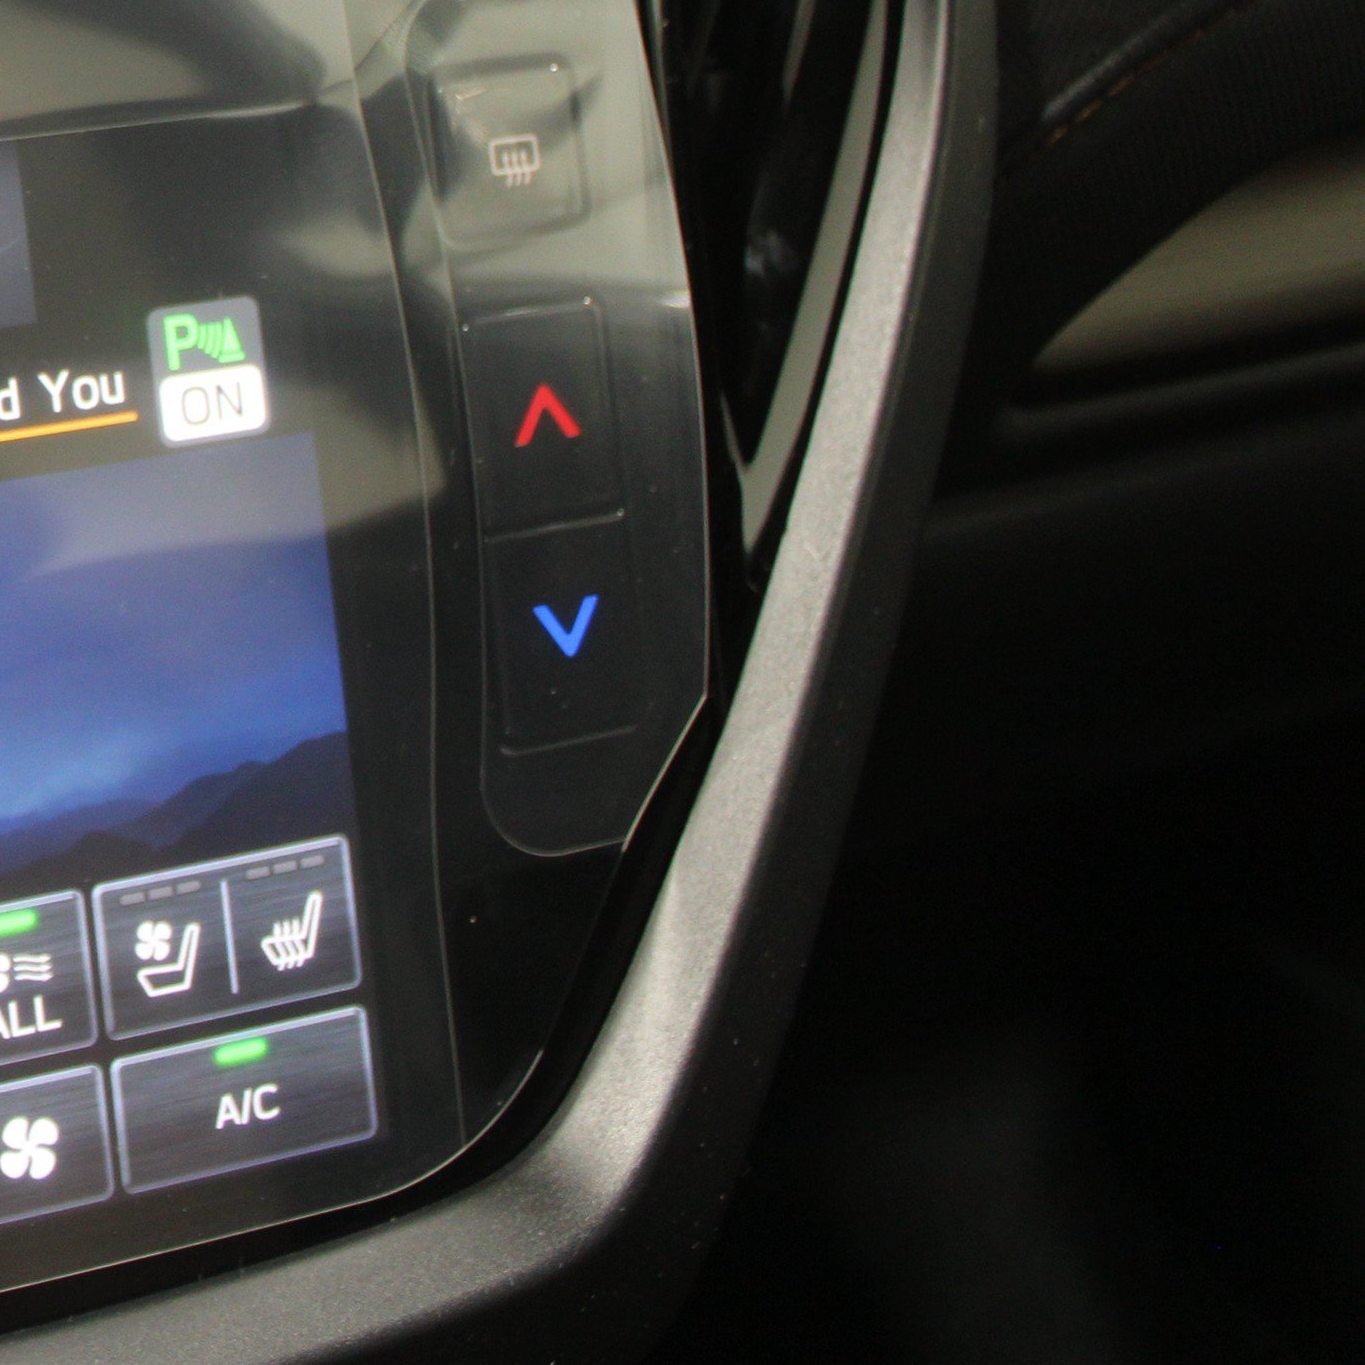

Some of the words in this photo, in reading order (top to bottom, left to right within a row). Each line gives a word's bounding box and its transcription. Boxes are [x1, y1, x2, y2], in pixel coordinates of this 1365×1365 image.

[36, 366, 126, 415] You
[181, 380, 245, 428] ON
[214, 1083, 282, 1131] A/C
